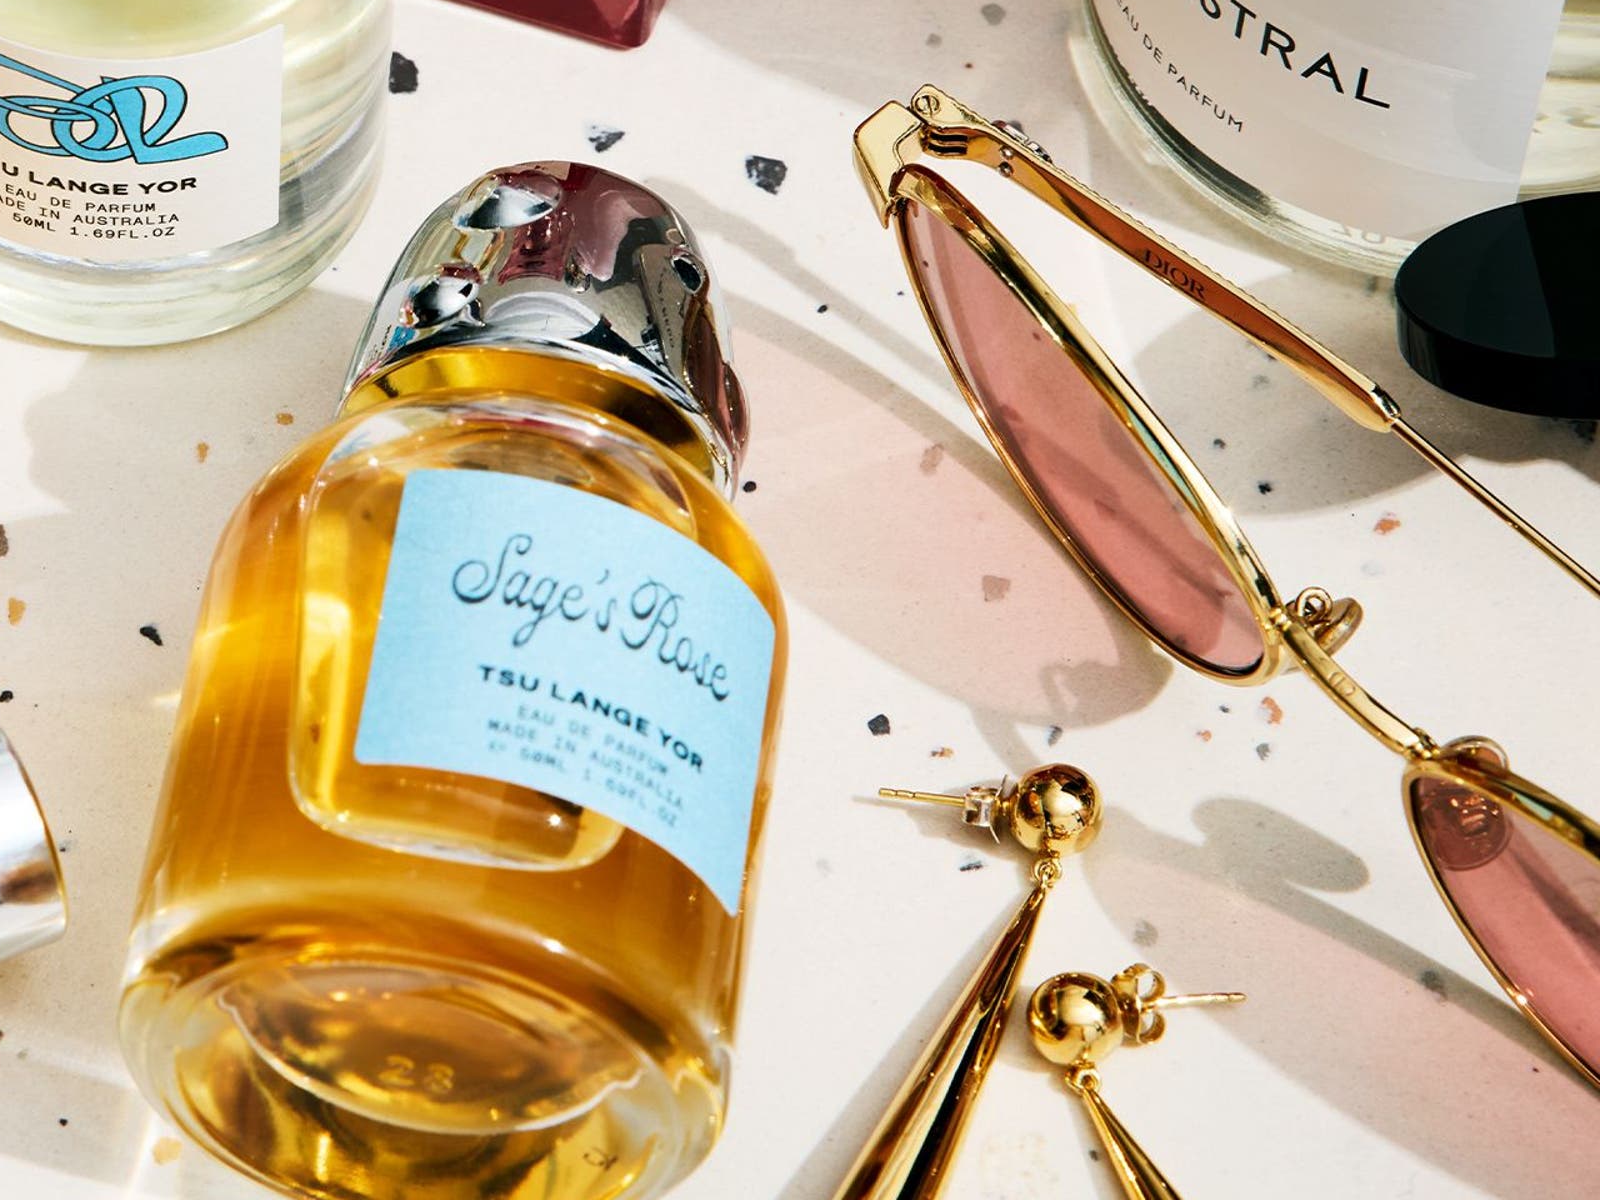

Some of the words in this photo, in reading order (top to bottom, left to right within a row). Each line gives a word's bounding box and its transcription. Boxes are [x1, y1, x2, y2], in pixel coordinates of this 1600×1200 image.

[1143, 33, 1163, 64] DE
[1167, 63, 1244, 133] PARFUM
[5, 183, 38, 202] EAU
[50, 196, 72, 210] DE
[85, 201, 157, 214] PARFUM
[28, 170, 129, 196] LANGE
[138, 176, 198, 196] YOR
[12, 213, 57, 233] 50ML
[69, 226, 176, 241] 1.69FL.OZ
[39, 206, 61, 221] IN
[73, 212, 180, 226] AUSTRALIA
[1144, 249, 1206, 301] DIOR
[451, 533, 618, 649] Sage's
[619, 575, 730, 703] Rose
[478, 664, 539, 693] TSU
[550, 683, 651, 738] LANGE
[657, 727, 705, 773] YOR
[517, 704, 555, 726] EAU
[568, 720, 590, 737] DE
[604, 733, 669, 776] PARFUM
[488, 719, 537, 743] MADE
[555, 736, 577, 754] IN
[590, 750, 684, 810] AUSTRALIA
